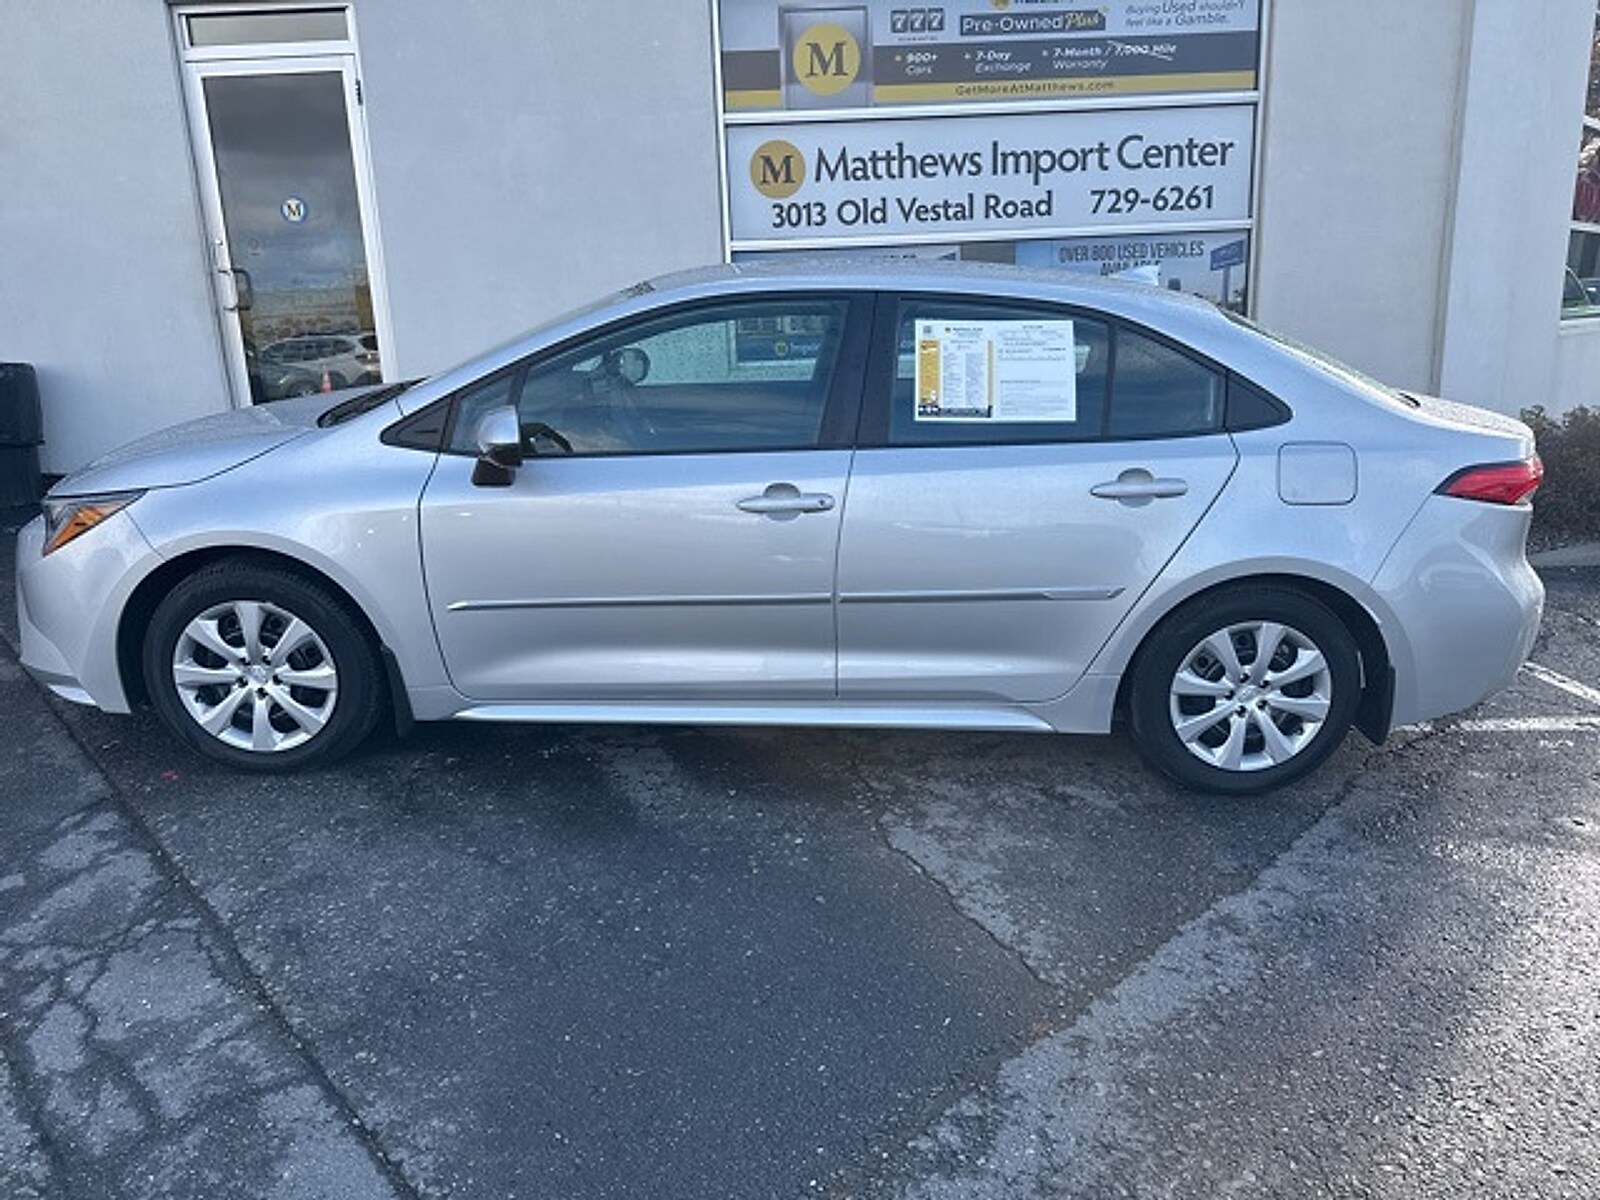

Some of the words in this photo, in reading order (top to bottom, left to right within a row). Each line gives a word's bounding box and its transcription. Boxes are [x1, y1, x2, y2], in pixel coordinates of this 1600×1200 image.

[1162, 0, 1196, 13] Used
[962, 15, 1064, 33] Pre-Owned
[805, 41, 849, 78] M
[976, 49, 1011, 61] 7-Day
[1053, 58, 1108, 70] Warranty
[905, 64, 932, 76] Cars
[975, 61, 1031, 74] Exchange
[955, 79, 1114, 97] GetMoreAtMatthews.com
[814, 141, 983, 183] Matthews
[992, 140, 1110, 186] Import
[1117, 134, 1235, 169] Center
[759, 154, 797, 186] M
[772, 202, 827, 229] 3013
[837, 197, 887, 226] Old
[895, 192, 975, 223] Vestal
[984, 190, 1053, 219] Road
[1090, 184, 1215, 215] 729-6261
[1058, 245, 1089, 264] OVER
[1118, 241, 1149, 260] USED
[1150, 239, 1205, 258] VEHICLES
